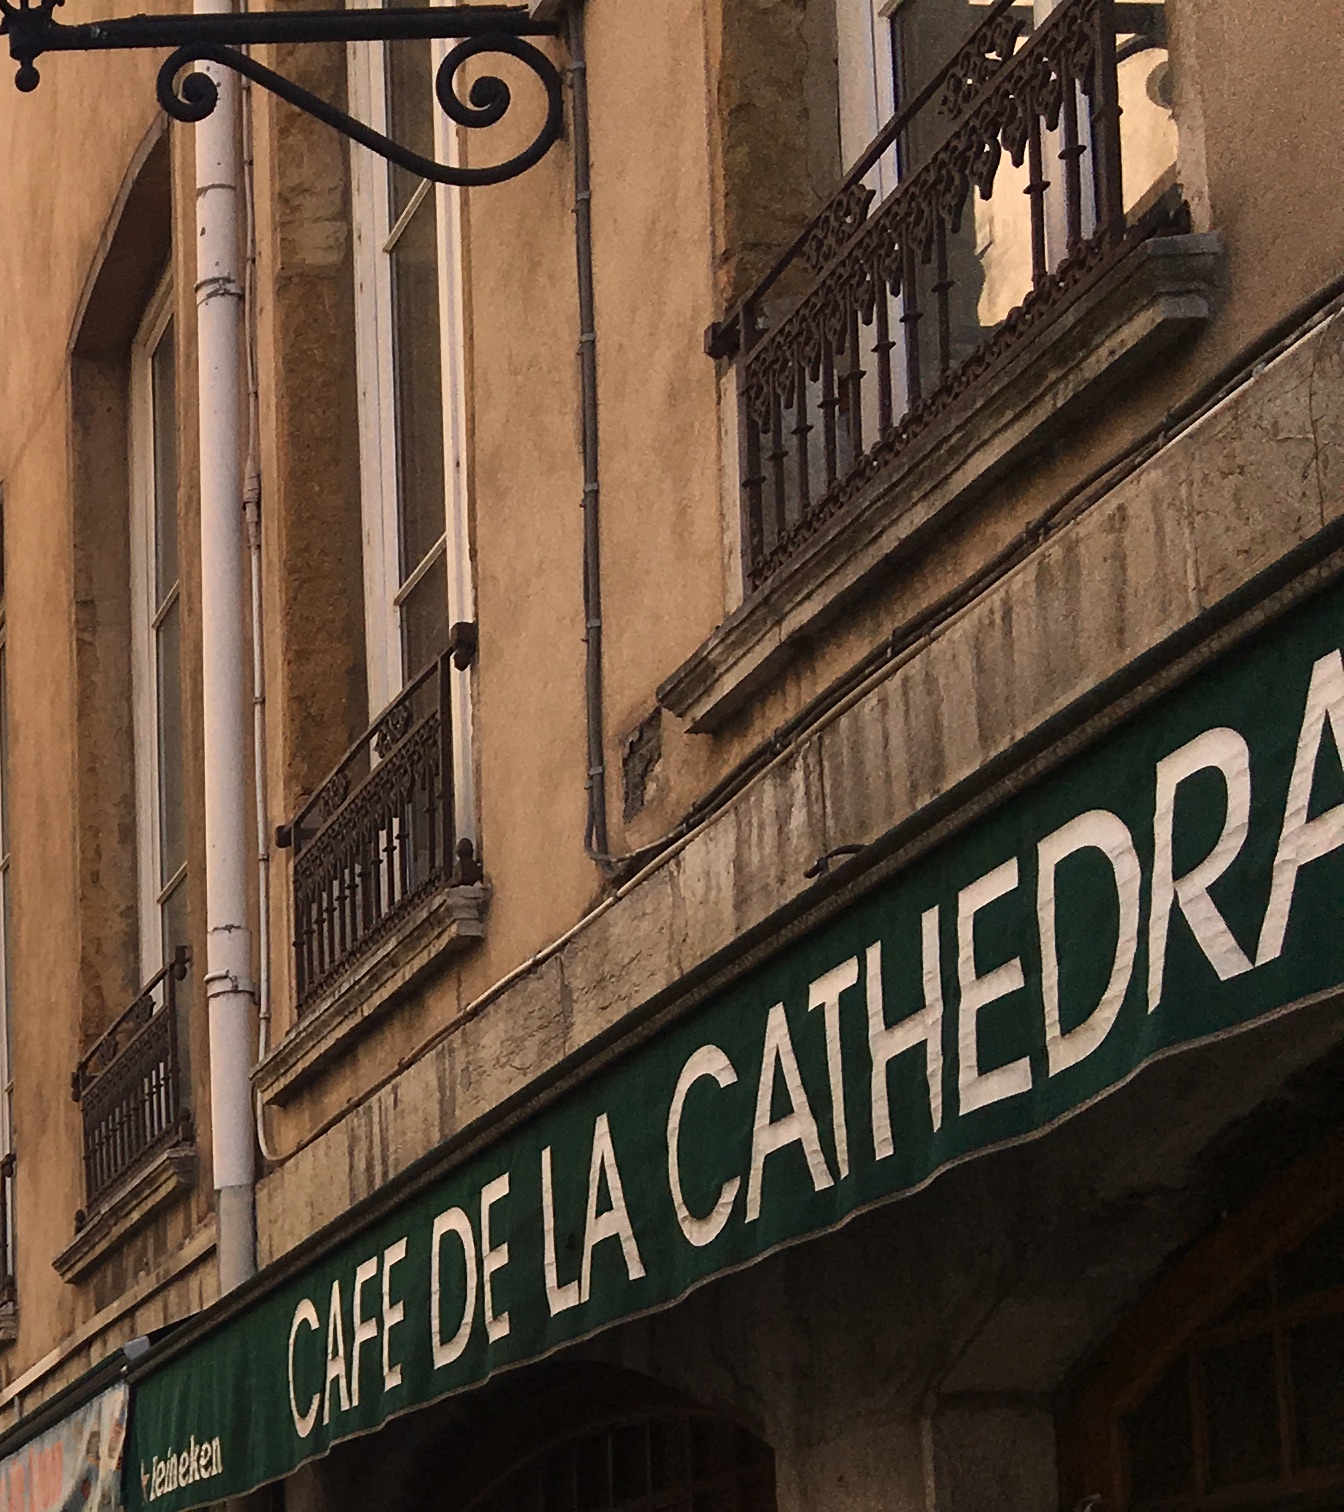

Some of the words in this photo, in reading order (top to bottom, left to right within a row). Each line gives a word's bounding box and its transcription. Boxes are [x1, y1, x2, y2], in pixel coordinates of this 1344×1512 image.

[287, 1236, 408, 1438] CAFE
[430, 1172, 510, 1370] DE
[540, 1112, 646, 1318] LA
